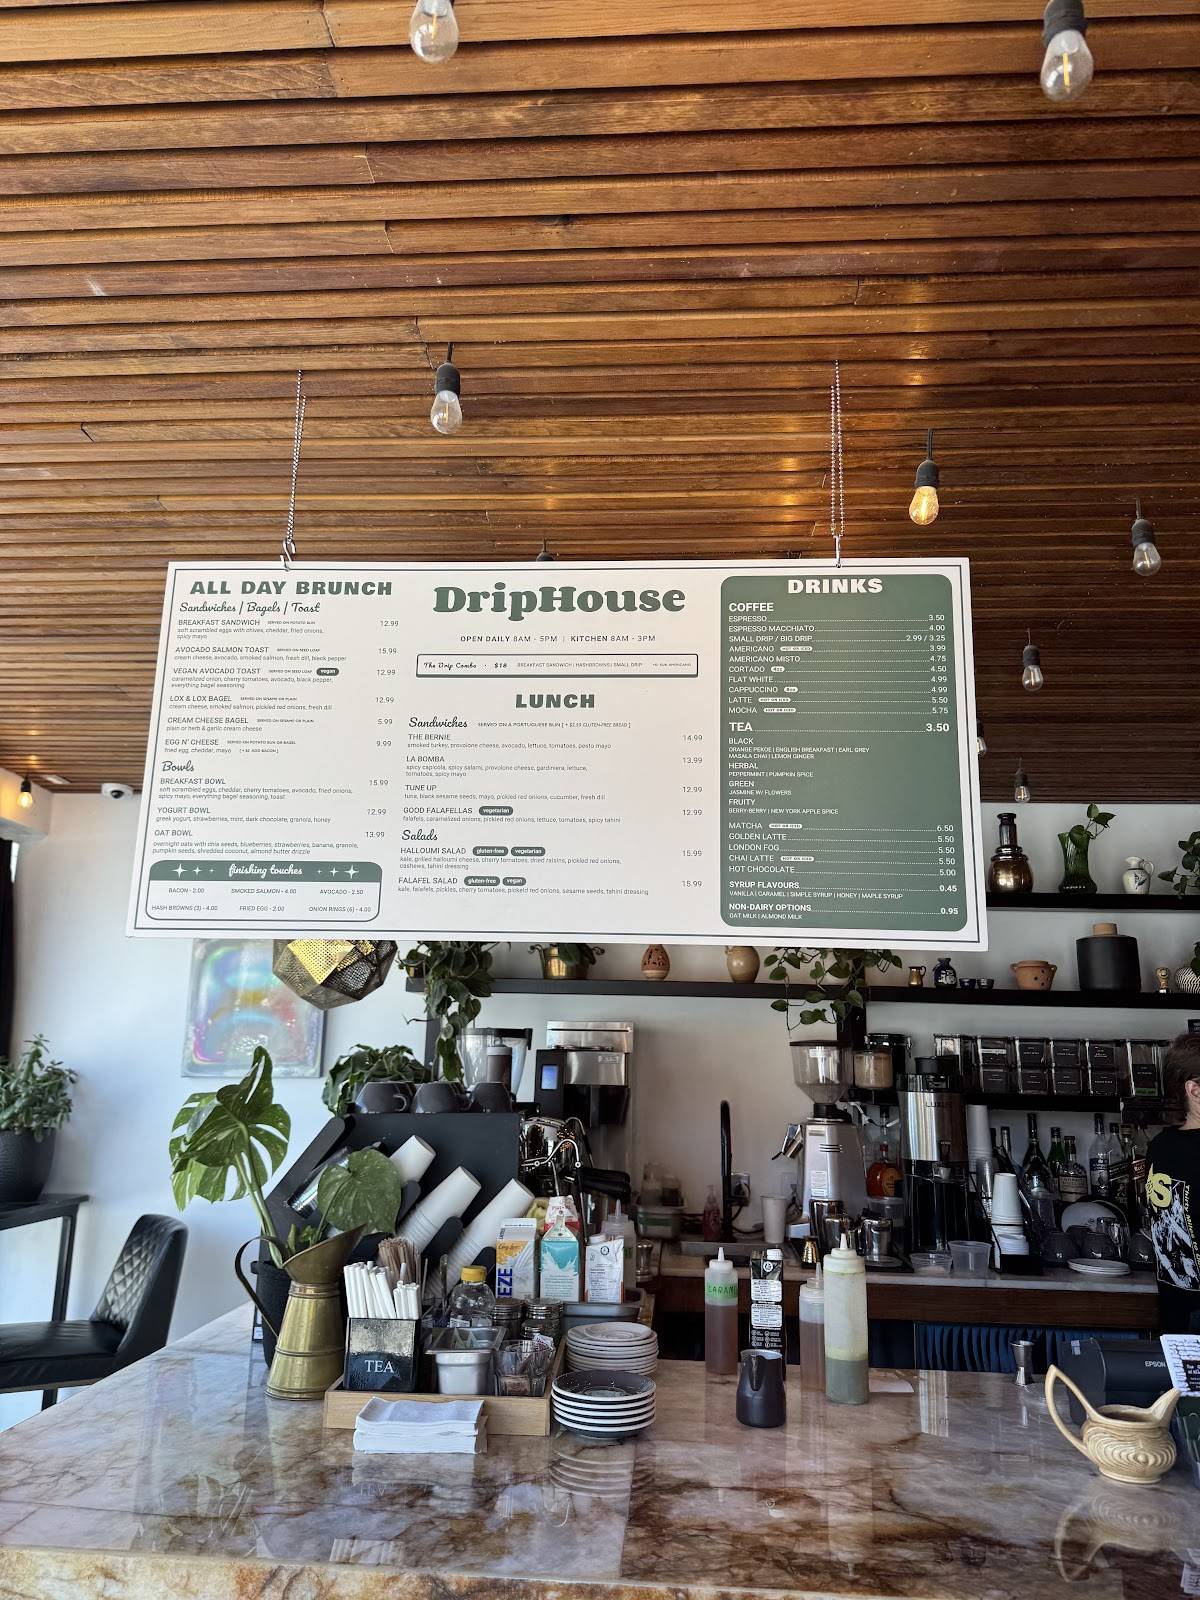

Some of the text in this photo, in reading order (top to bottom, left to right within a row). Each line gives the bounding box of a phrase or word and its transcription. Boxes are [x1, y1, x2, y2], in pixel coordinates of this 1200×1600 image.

[190, 581, 392, 595] ALL DAY BRUNCH
[788, 579, 883, 594] DRINKS
[180, 602, 320, 616] Sandwiches Bagels Toast
[433, 583, 685, 621] DripHouse
[729, 603, 773, 612] COFFEE
[516, 694, 595, 708] LUNCH
[409, 717, 467, 728] Sandwiches
[729, 722, 752, 731] TEA
[926, 723, 949, 732] 3.50
[162, 761, 194, 772] Bowls
[402, 830, 437, 841] Salads
[229, 864, 302, 878] finishing touches
[364, 1360, 394, 1374] TEA
